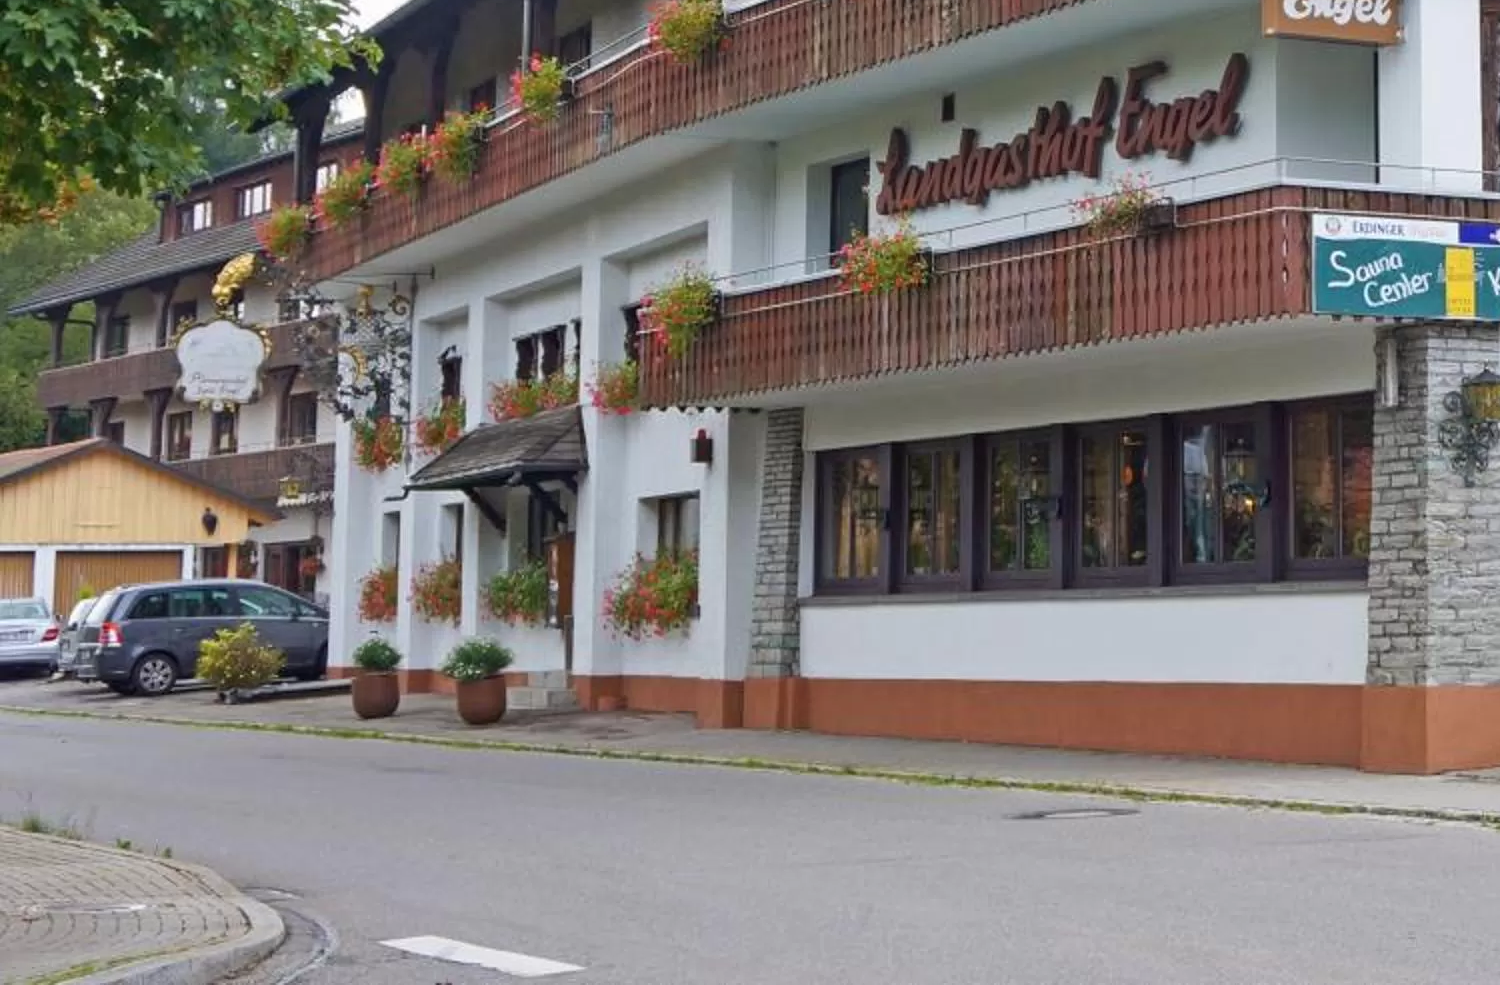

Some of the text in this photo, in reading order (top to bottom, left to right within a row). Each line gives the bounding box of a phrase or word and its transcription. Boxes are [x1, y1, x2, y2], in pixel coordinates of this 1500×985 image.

[876, 52, 1249, 215] Landgasthof Engel
[1352, 220, 1405, 237] ERDINGER
[1328, 250, 1403, 287] Sauna
[1363, 272, 1432, 307] Center
